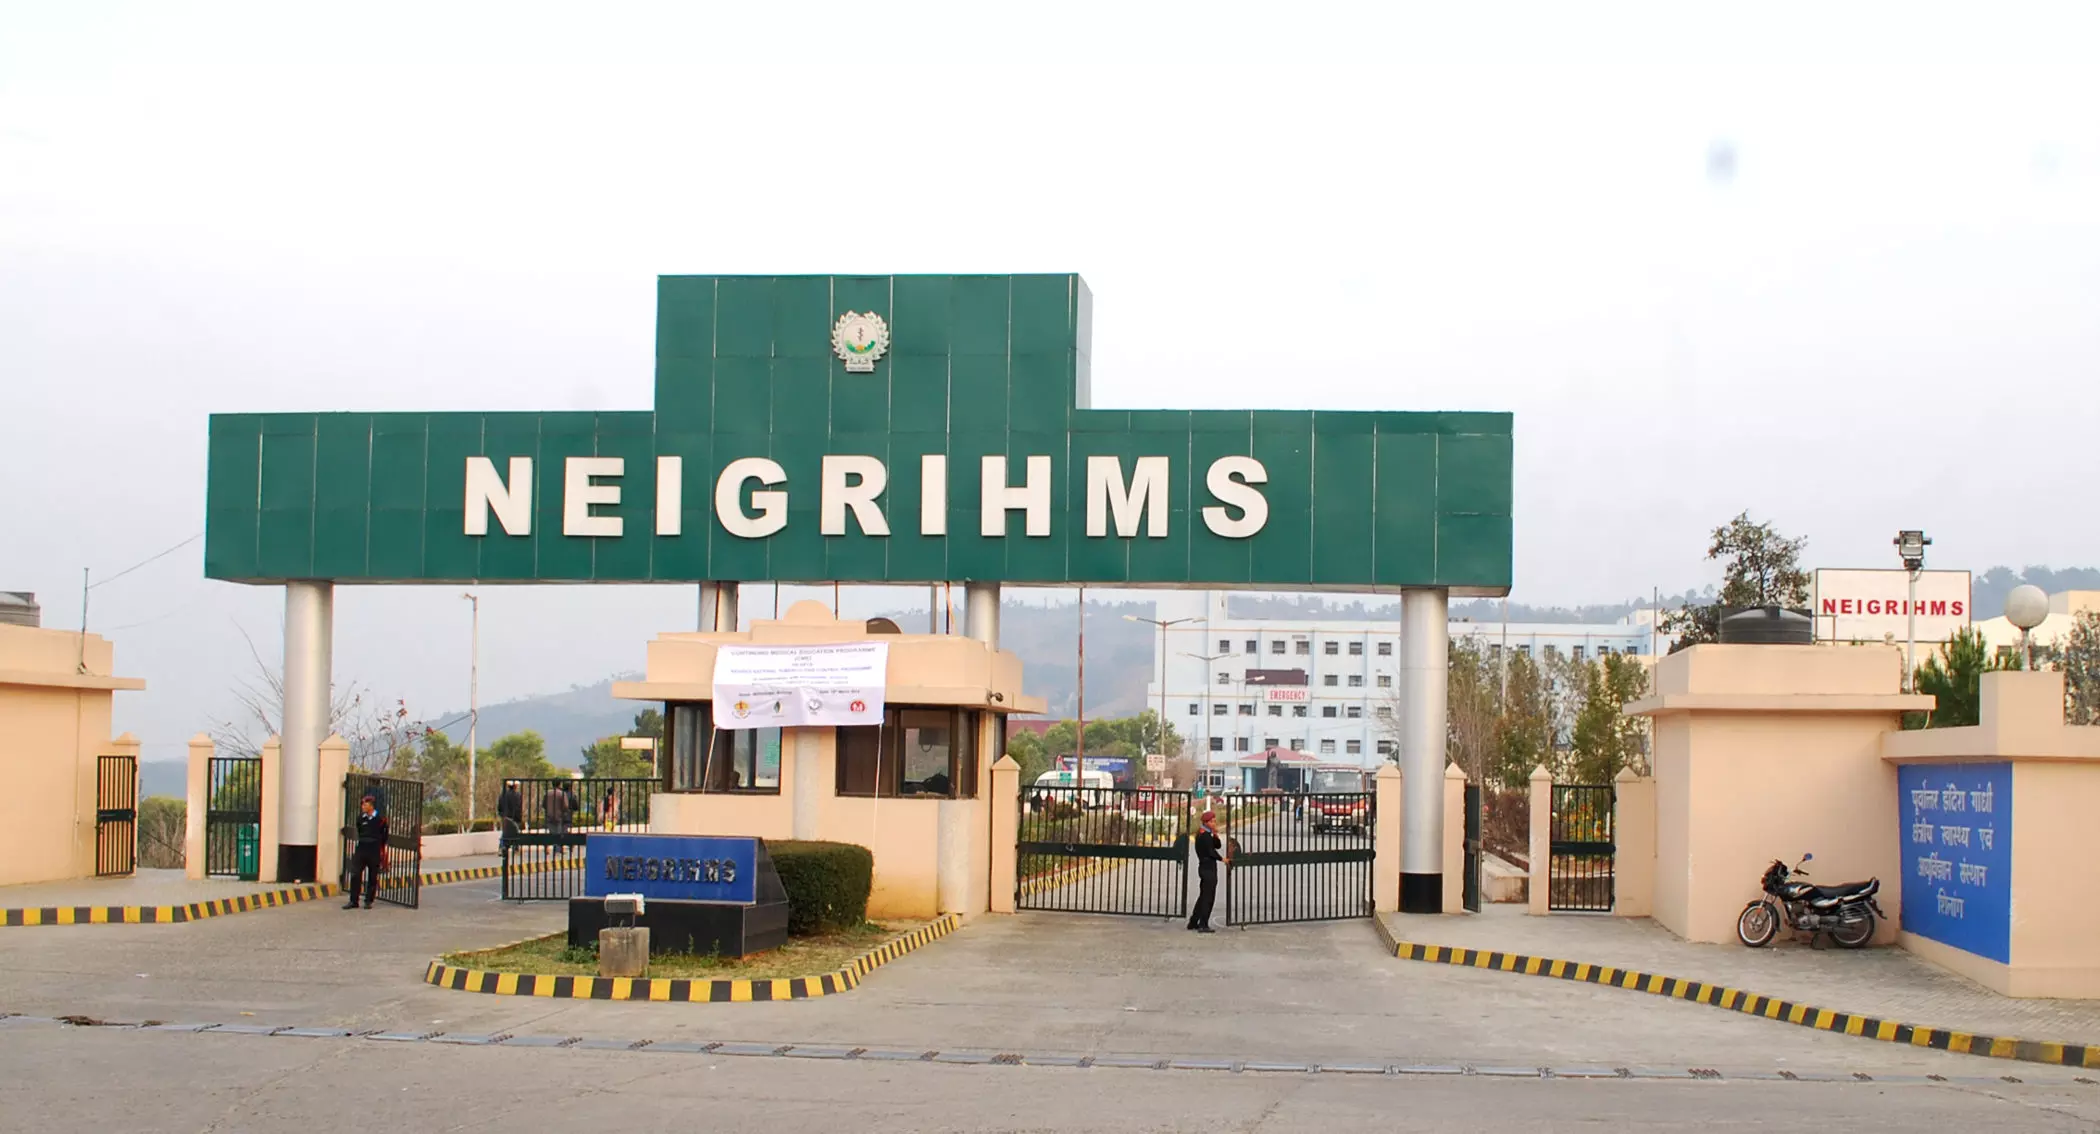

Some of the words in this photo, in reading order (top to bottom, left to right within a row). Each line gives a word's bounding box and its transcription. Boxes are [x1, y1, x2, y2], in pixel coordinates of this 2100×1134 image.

[463, 455, 1269, 538] NEIGRIHMS
[1822, 598, 1964, 616] NEIGRIHMS
[1269, 690, 1305, 701] EMERGENCY
[1970, 781, 1993, 813] गांधी
[1940, 825, 1971, 848] स्वास्थ्य
[1978, 821, 1994, 851] एवं
[605, 855, 737, 884] NEIGRIHMS
[1958, 857, 1988, 888] संस्थान
